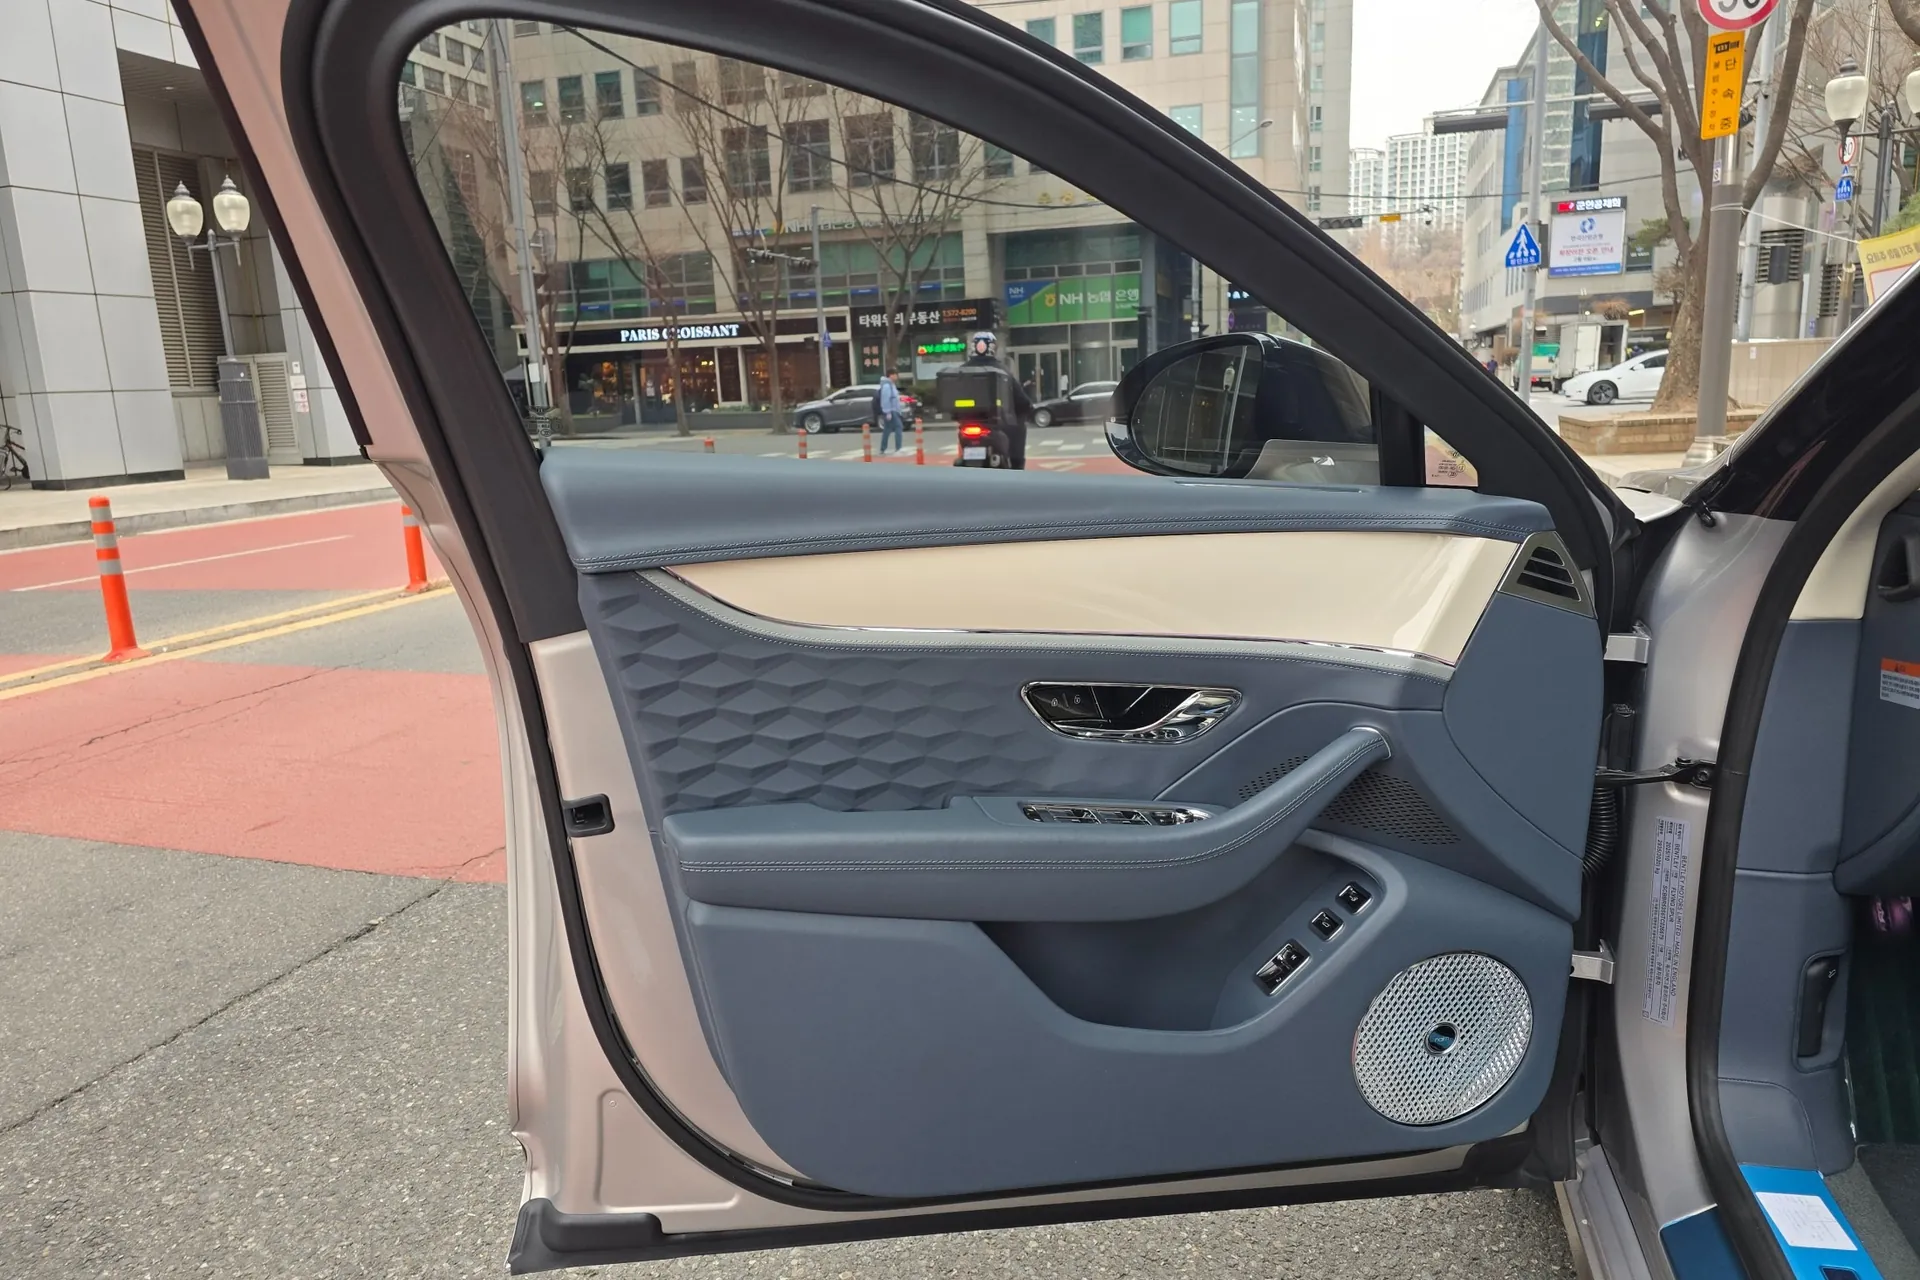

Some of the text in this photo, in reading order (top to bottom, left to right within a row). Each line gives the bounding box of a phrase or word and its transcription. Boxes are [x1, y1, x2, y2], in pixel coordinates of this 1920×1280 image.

[1009, 287, 1024, 295] NH
[620, 324, 739, 342] PARIS COISSANT
[1673, 843, 1681, 869] BENTLEY
[1679, 855, 1688, 883] BENTLEY
[1677, 884, 1685, 911] MOTORS
[1670, 966, 1678, 997] ENGLAND
